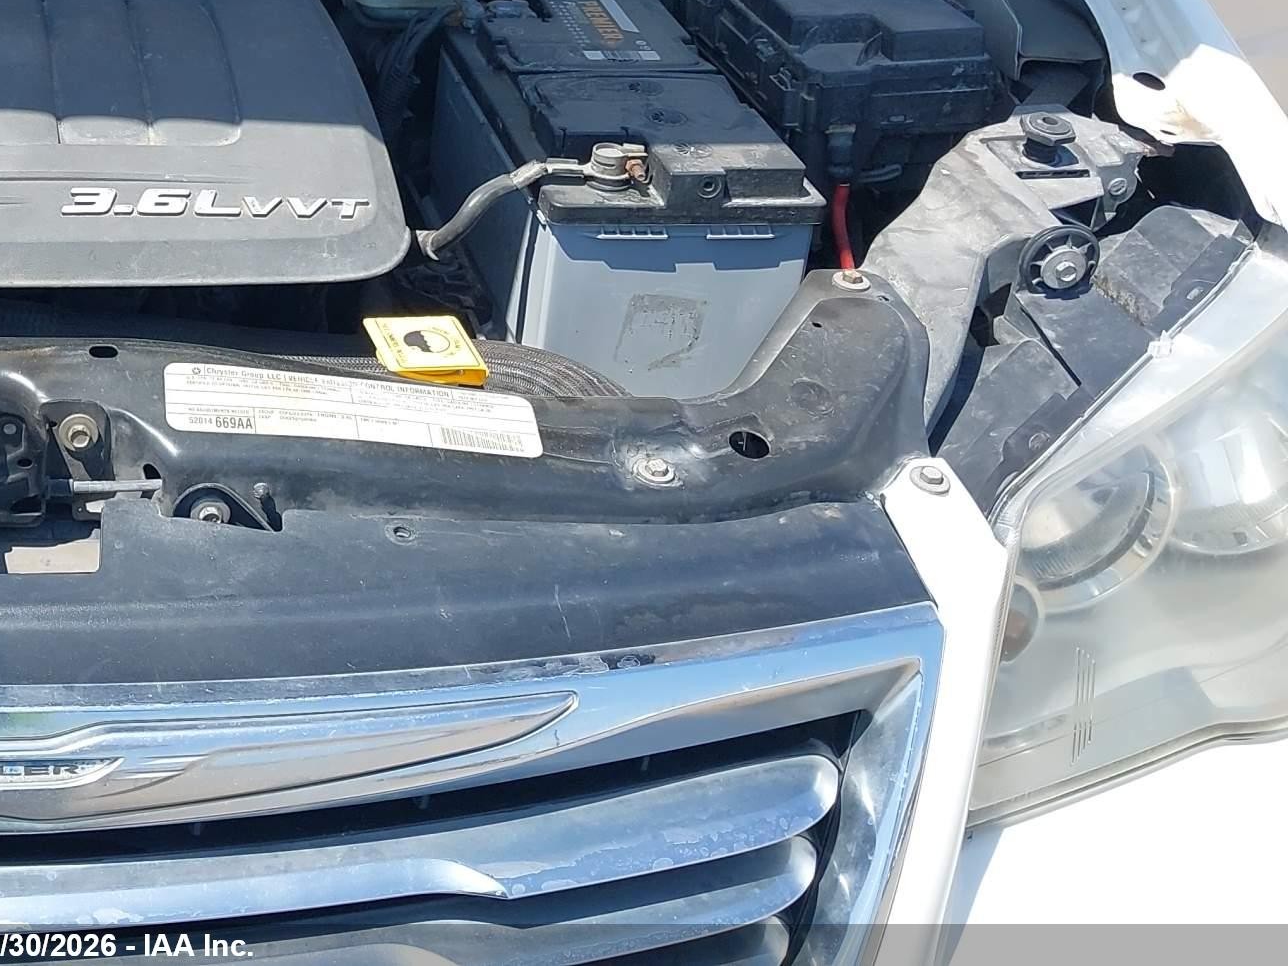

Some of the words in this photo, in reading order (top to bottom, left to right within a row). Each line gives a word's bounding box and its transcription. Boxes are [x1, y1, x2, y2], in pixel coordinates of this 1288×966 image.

[578, 0, 624, 39] PREMIER
[206, 367, 238, 377] Chrysler
[241, 370, 264, 380] Group
[397, 385, 450, 397] INFORMATION
[189, 416, 213, 425] 52014
[216, 416, 254, 430] 669AA
